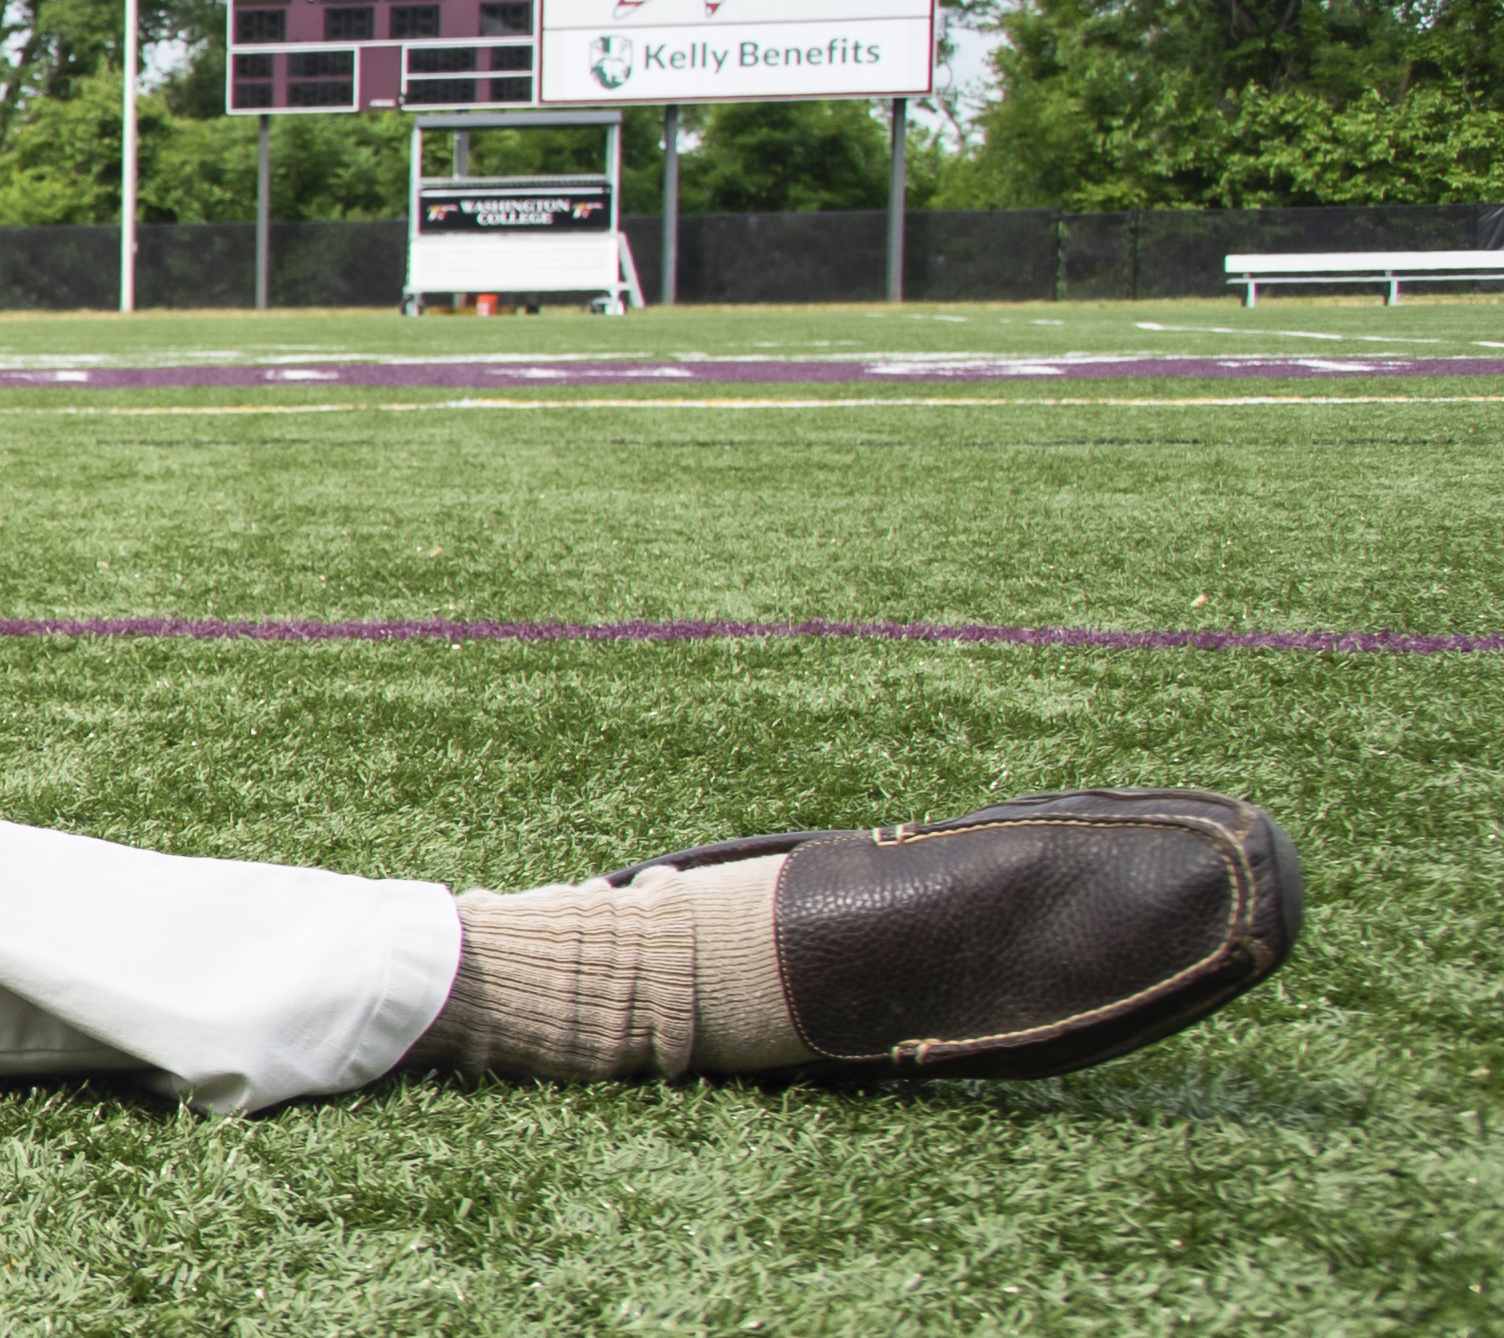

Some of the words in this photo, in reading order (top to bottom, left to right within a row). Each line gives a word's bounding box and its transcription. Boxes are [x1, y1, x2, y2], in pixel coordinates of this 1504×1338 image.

[644, 42, 730, 73] Kelly
[738, 38, 881, 68] Benefits
[460, 198, 571, 214] WASHINGTON
[477, 211, 554, 226] COLLEGE
